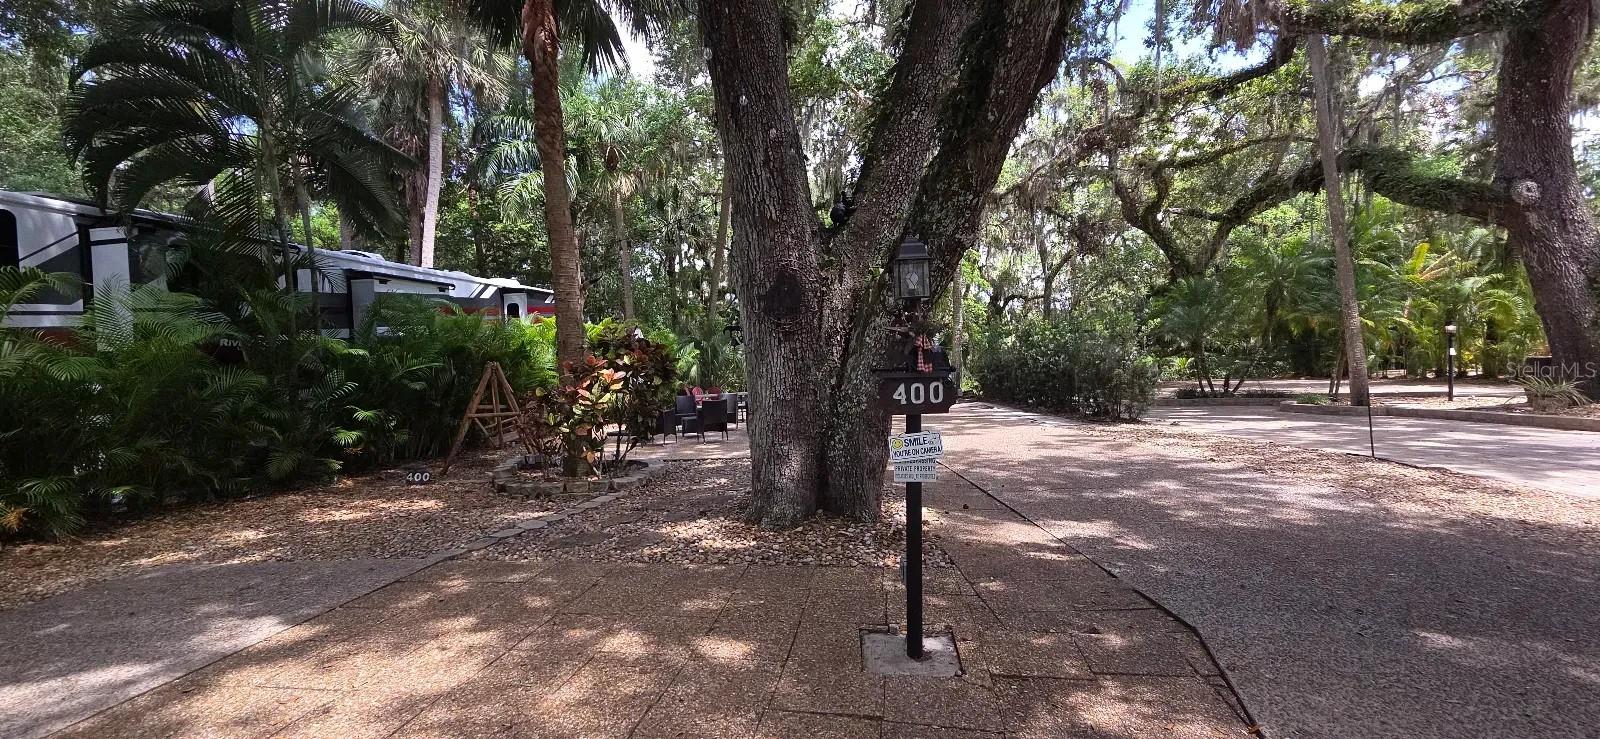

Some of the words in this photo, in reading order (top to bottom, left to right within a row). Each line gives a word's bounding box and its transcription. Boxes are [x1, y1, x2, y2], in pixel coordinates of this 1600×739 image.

[892, 381, 944, 404] 400
[904, 436, 928, 447] SMILE
[911, 448, 920, 456] ON
[406, 472, 430, 481] 400
